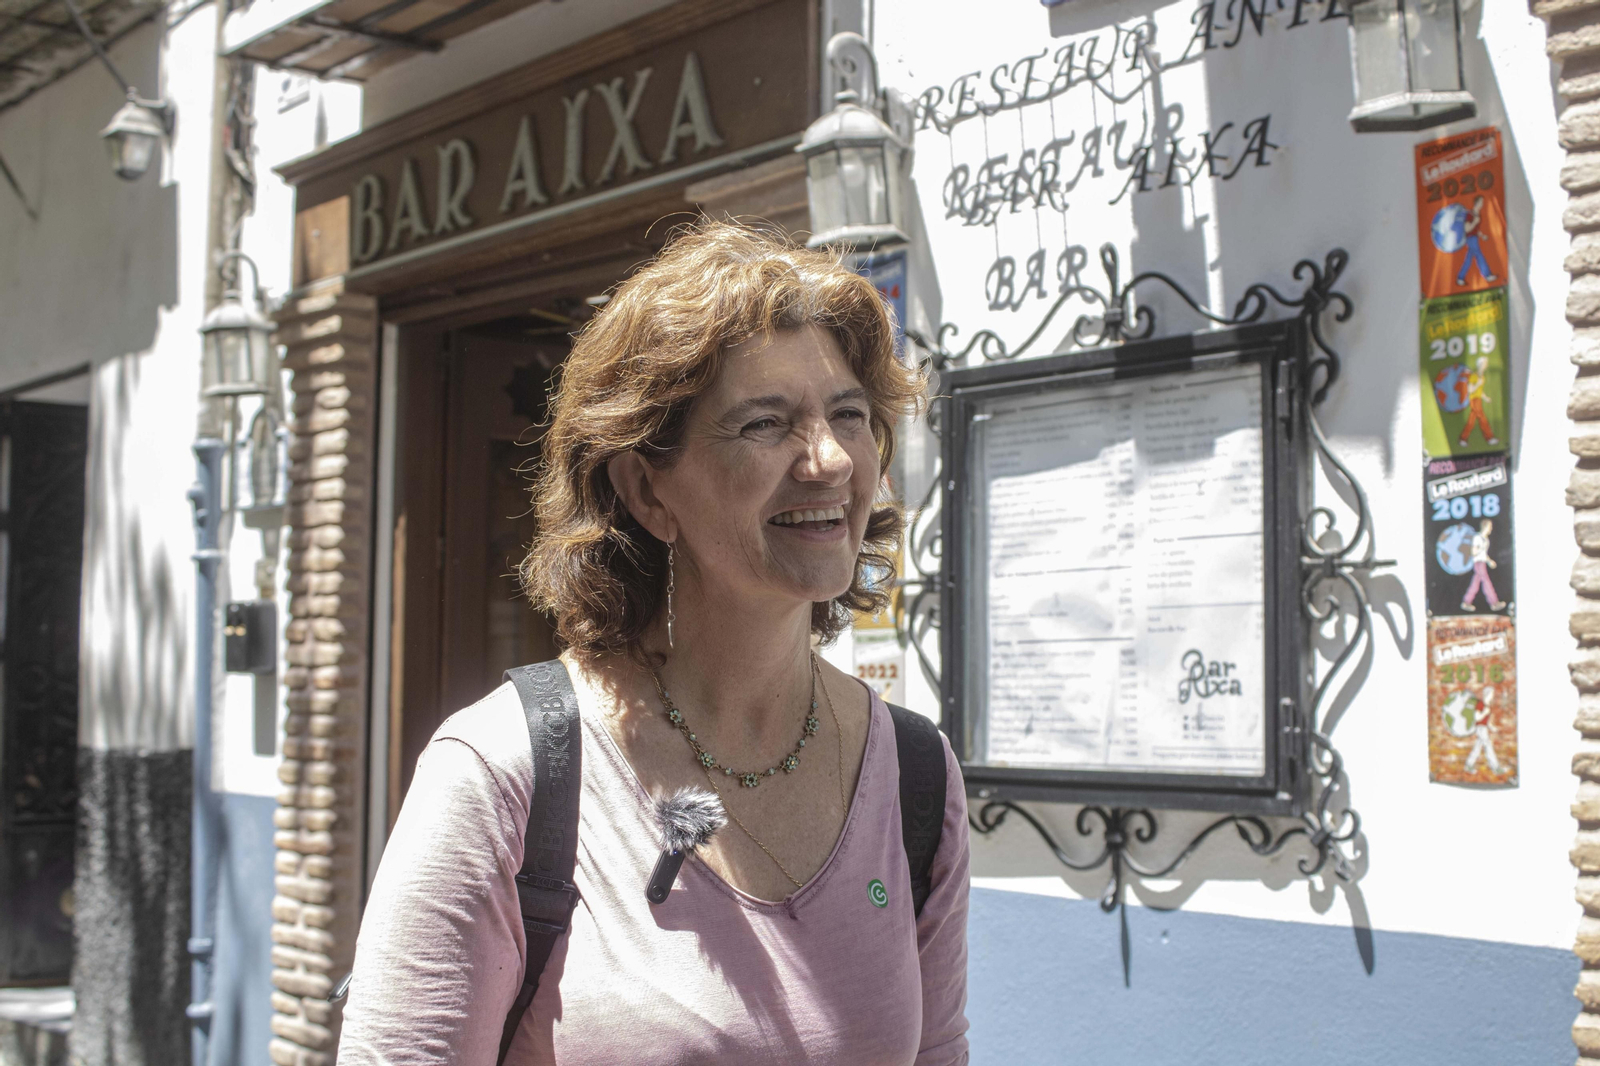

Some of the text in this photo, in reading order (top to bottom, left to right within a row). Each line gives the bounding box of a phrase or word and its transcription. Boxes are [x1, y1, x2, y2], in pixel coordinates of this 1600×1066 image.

[351, 51, 725, 263] BAR AIXA
[1108, 113, 1279, 206] AIXA
[1427, 170, 1495, 203] 2020
[1430, 331, 1496, 361] 2019
[1432, 493, 1501, 522] 2018
[858, 663, 898, 679] 2022
[1439, 663, 1505, 684] 2016
